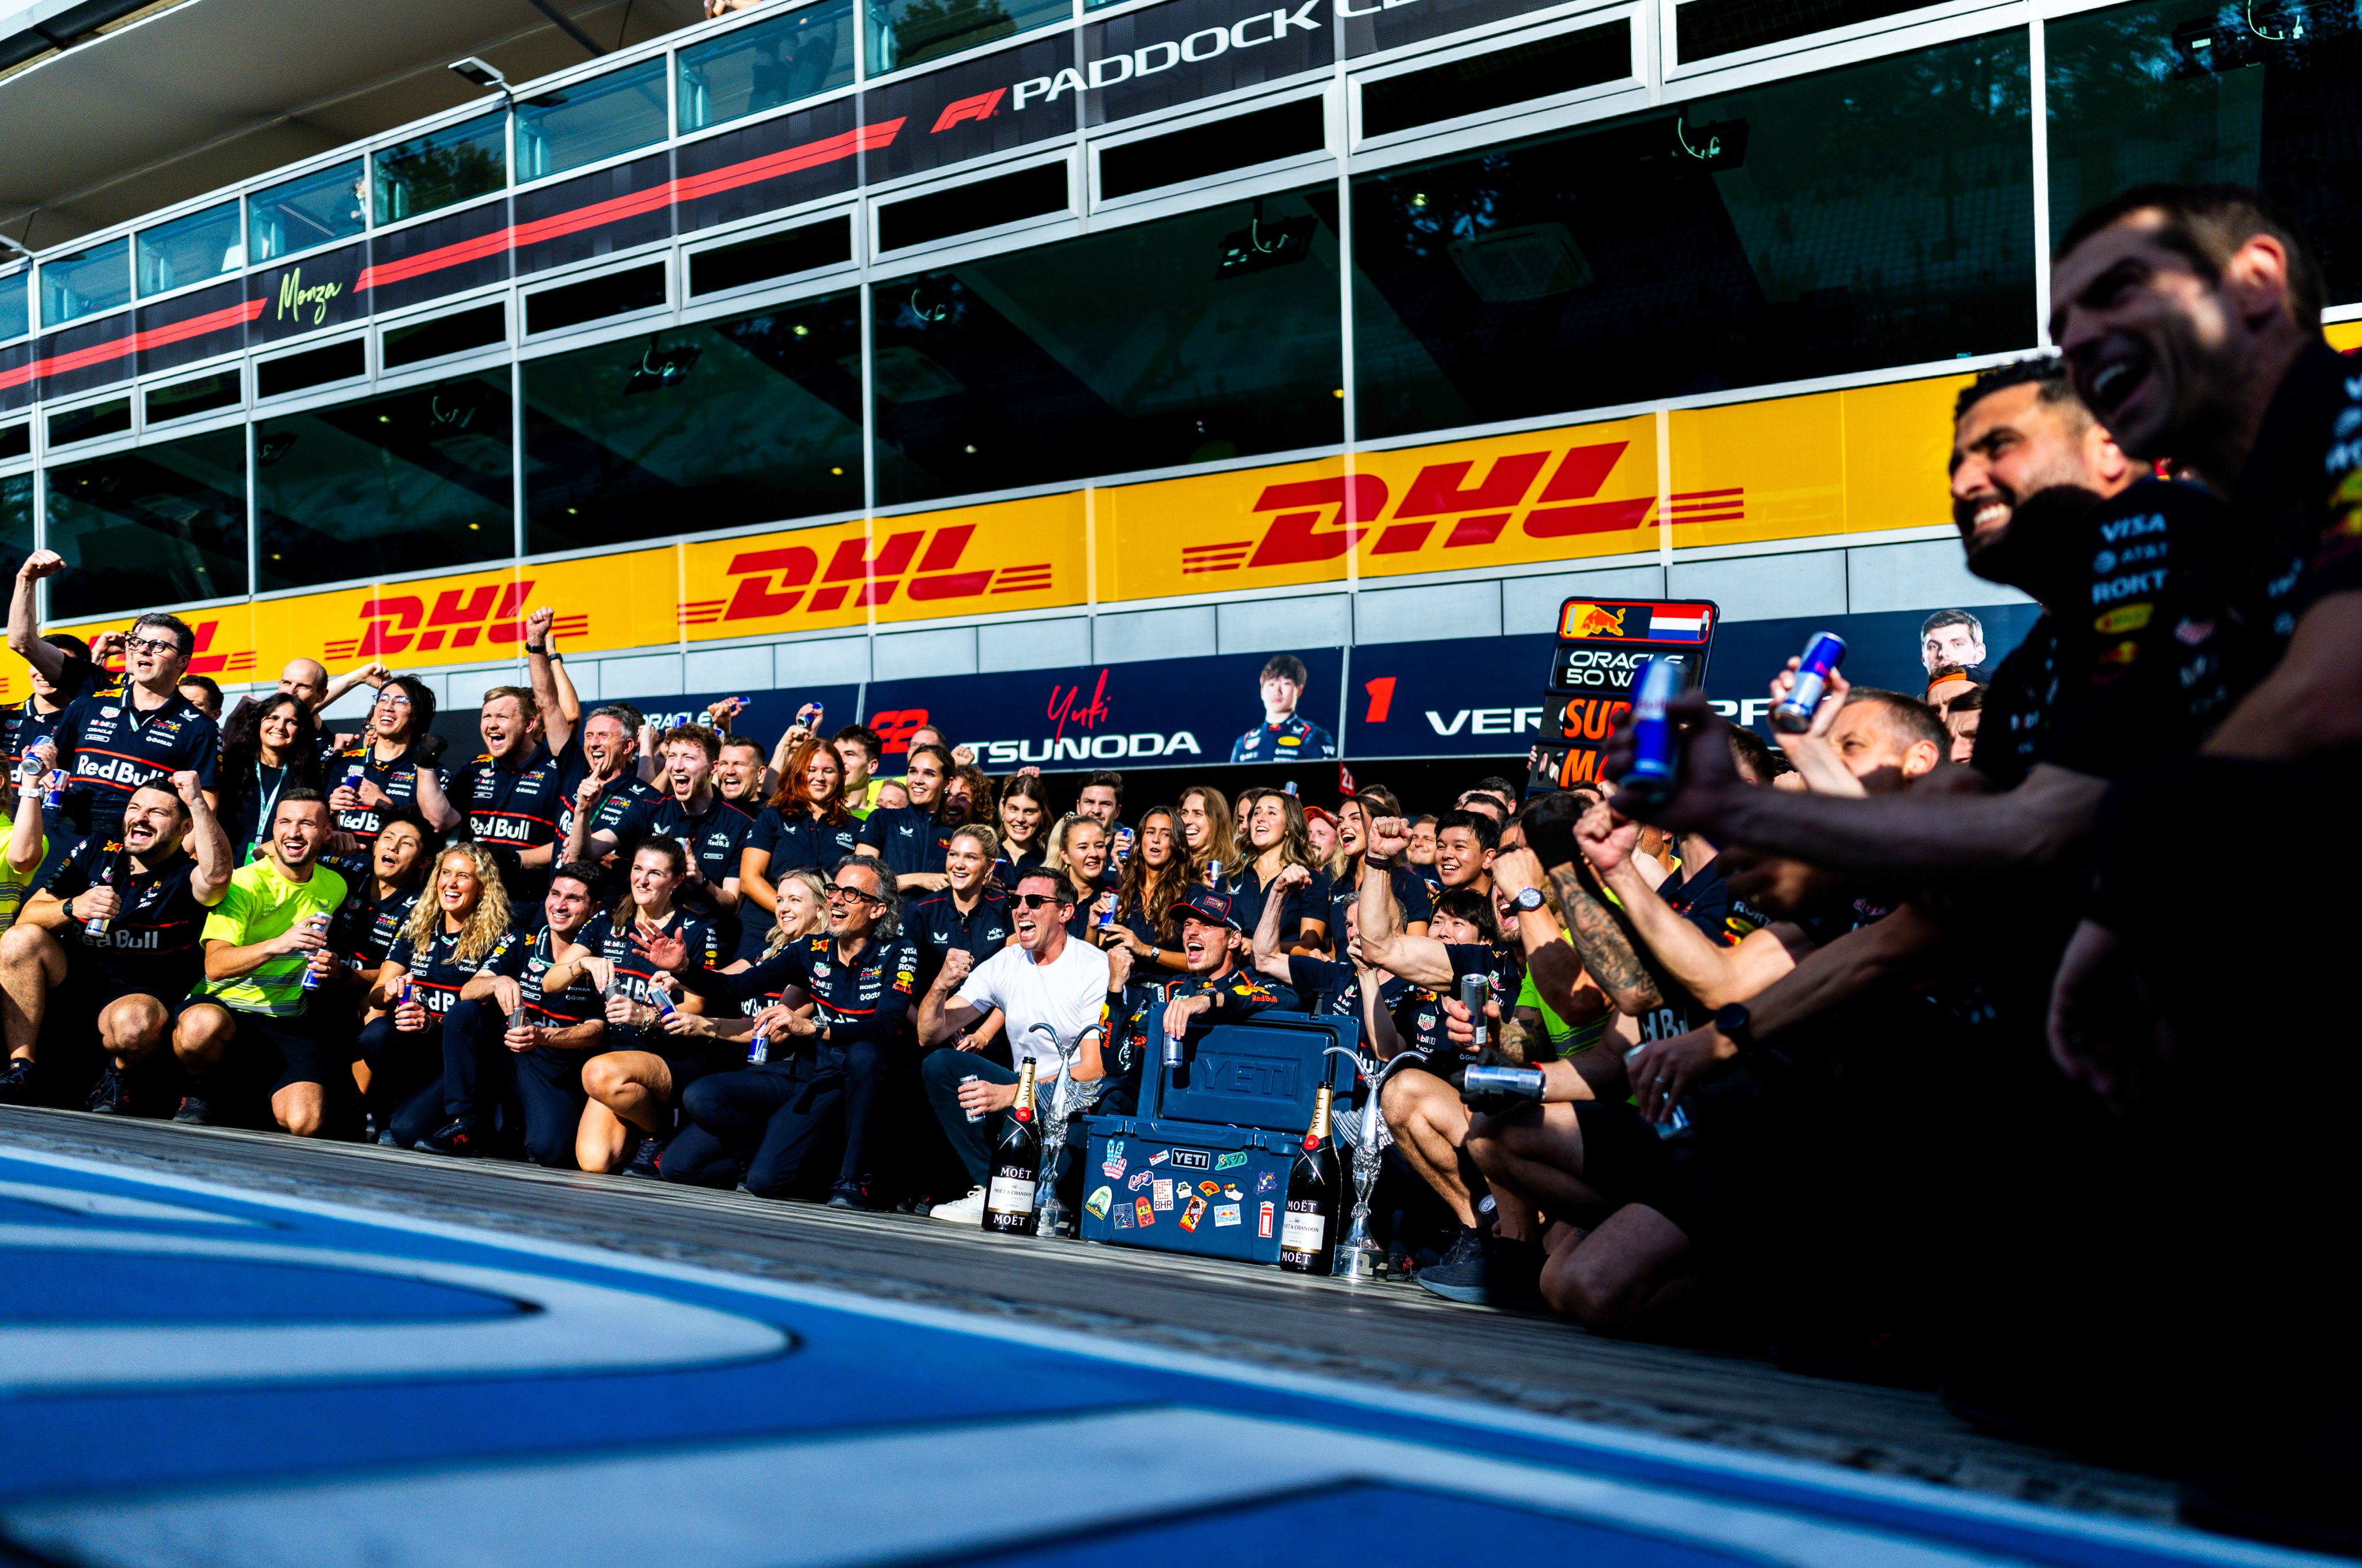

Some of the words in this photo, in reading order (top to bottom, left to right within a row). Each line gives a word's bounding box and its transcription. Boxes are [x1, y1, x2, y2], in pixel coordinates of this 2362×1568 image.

[1013, 0, 1322, 111] PADDOCK
[277, 268, 343, 325] Monza
[1249, 440, 1656, 567] DHL
[724, 524, 996, 622] DHL
[2092, 567, 2169, 606] ROKT
[357, 580, 535, 657] DHL
[1047, 668, 1111, 744] Yuki
[1365, 676, 1397, 723] 1
[960, 731, 1201, 764] TSUNODA
[77, 755, 115, 778] Red
[471, 817, 495, 835] Red
[495, 818, 530, 840] Bull
[115, 930, 158, 949] Bull
[520, 981, 541, 991] ORACLE
[521, 972, 538, 983] Mobil
[1252, 994, 1265, 1002] Red
[1265, 995, 1277, 1003] Bull
[1419, 1021, 1434, 1030] HEUER
[1198, 1056, 1297, 1097] YETI
[1175, 1152, 1206, 1166] YETI
[1001, 1167, 1032, 1179] MOËT
[1155, 1200, 1172, 1209] BHR
[1287, 1199, 1317, 1213] MOËT
[994, 1214, 1025, 1226] MOËT
[1281, 1251, 1311, 1264] MOËT
